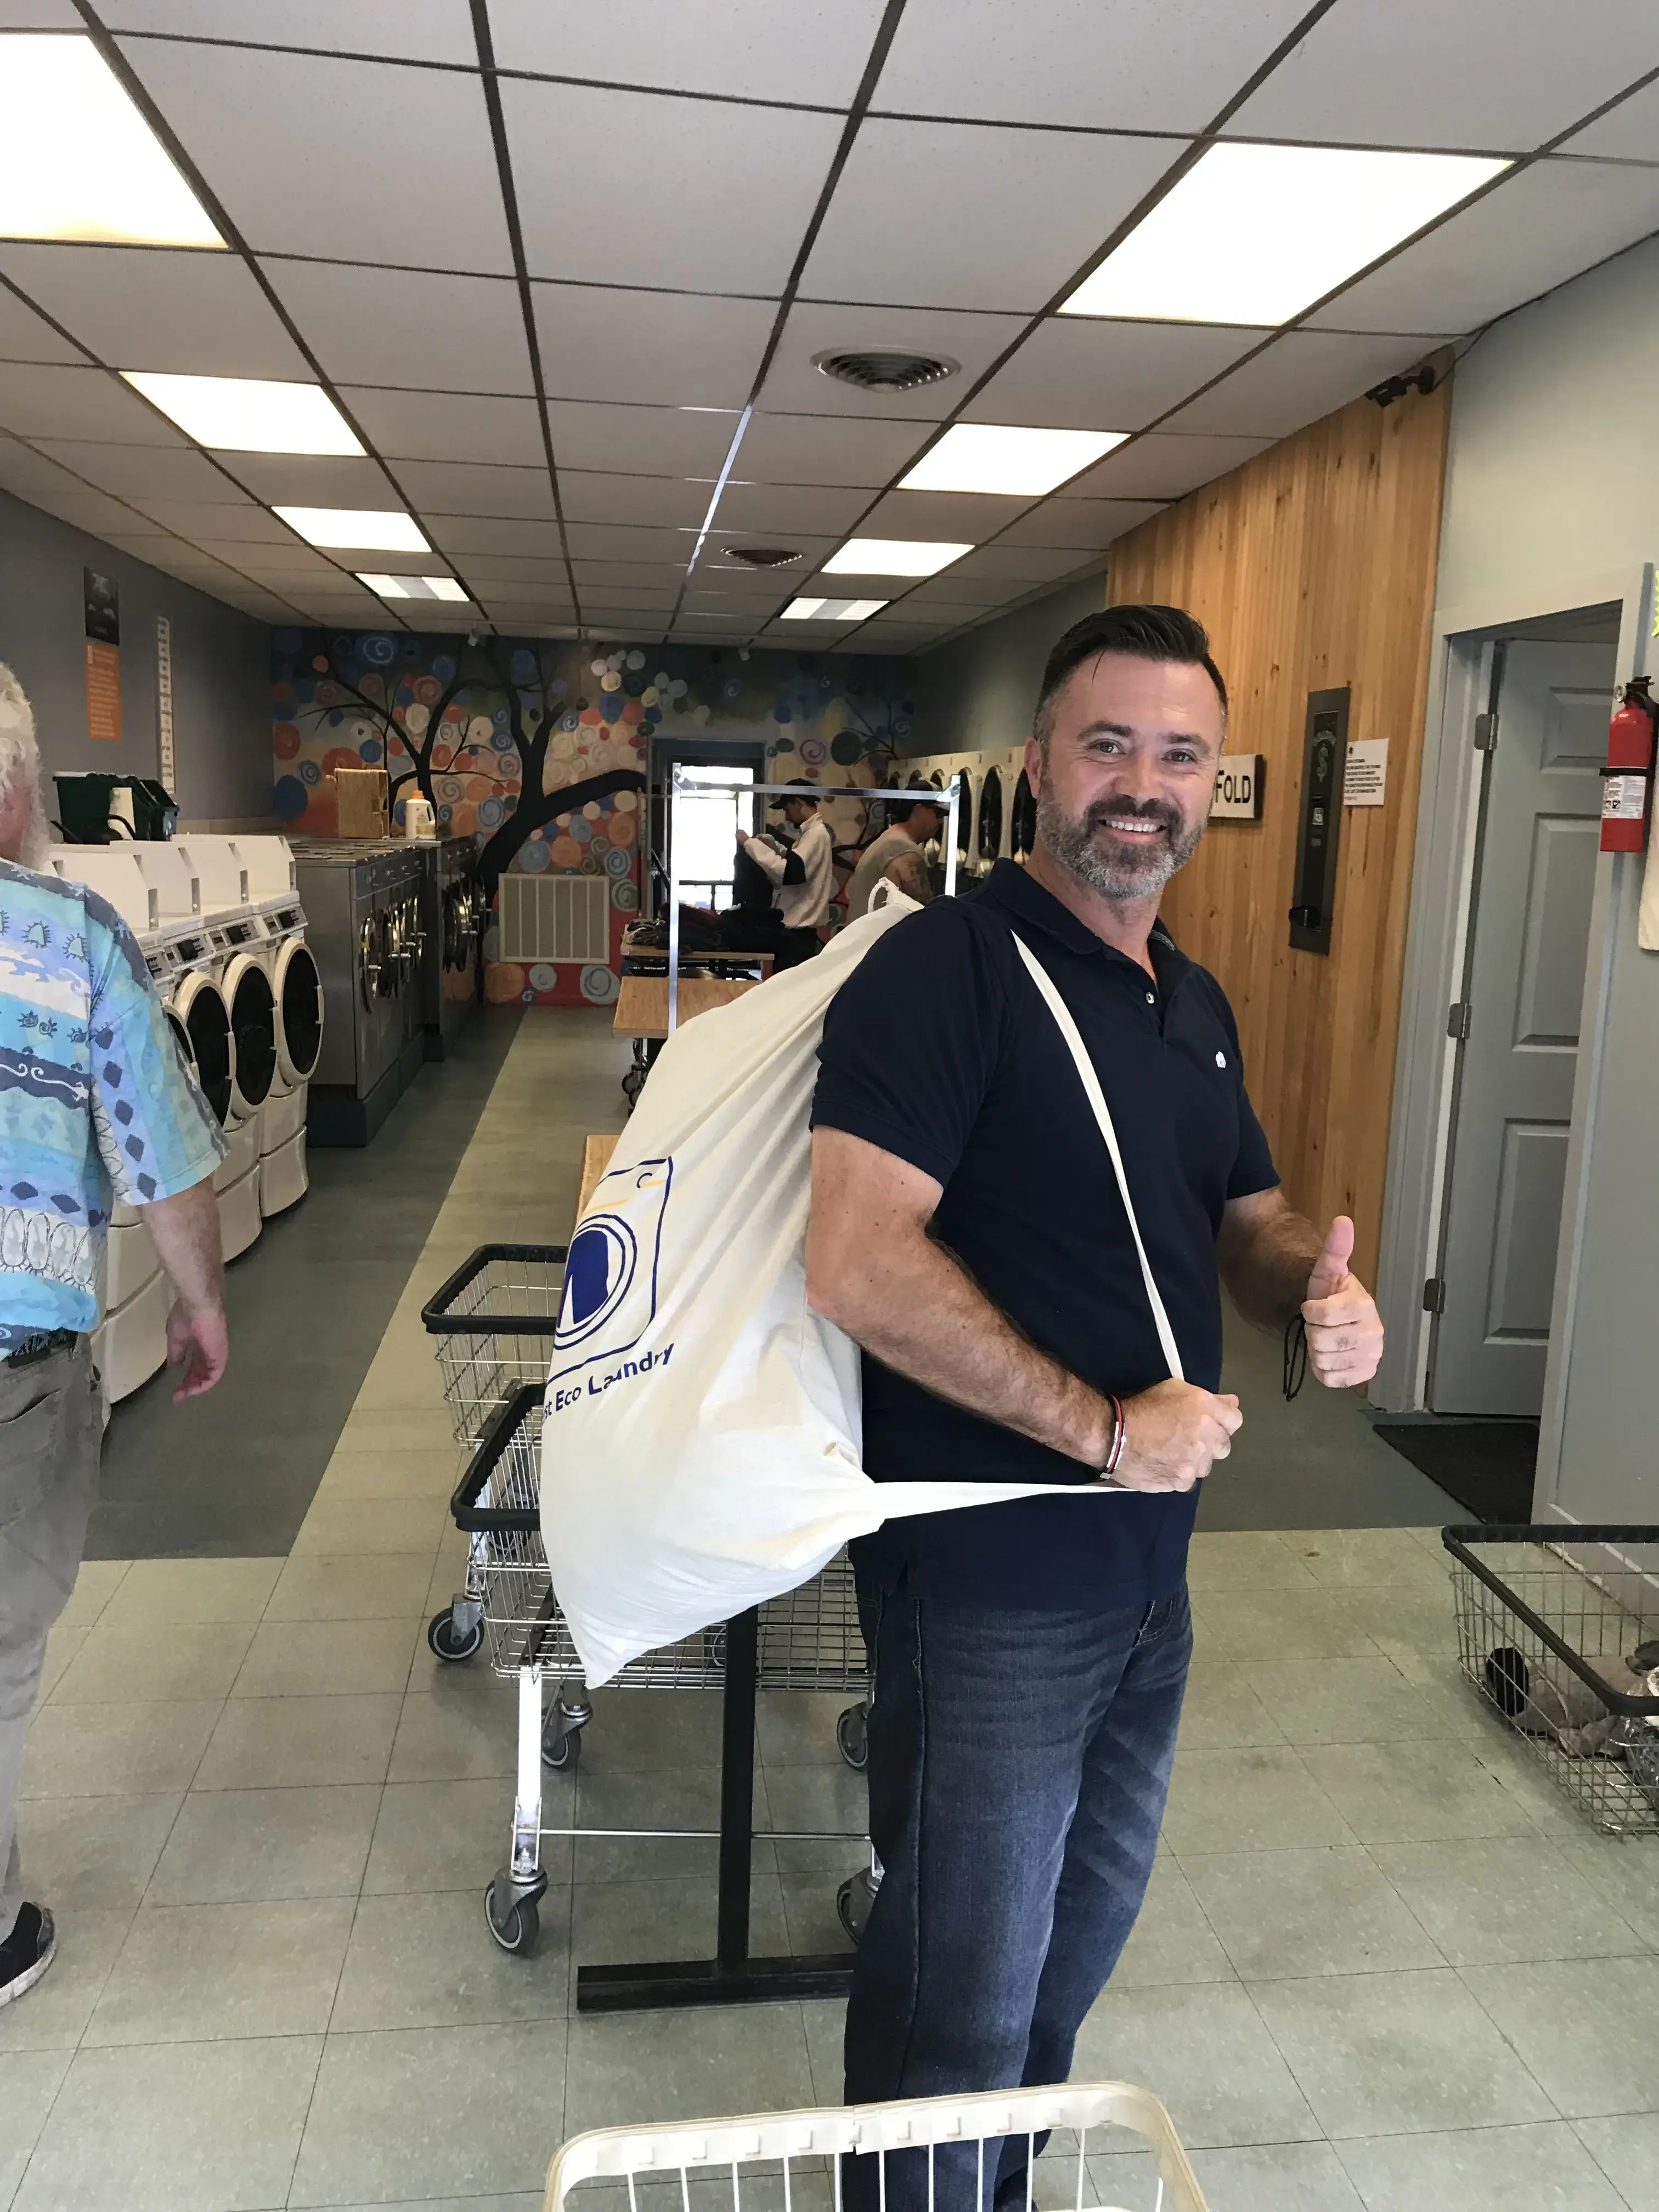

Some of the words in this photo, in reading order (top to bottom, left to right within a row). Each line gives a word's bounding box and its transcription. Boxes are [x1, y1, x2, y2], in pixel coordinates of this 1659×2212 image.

[1215, 770, 1251, 804] FOLD
[555, 1386, 582, 1412] Eco
[588, 1342, 675, 1396] Laundry
